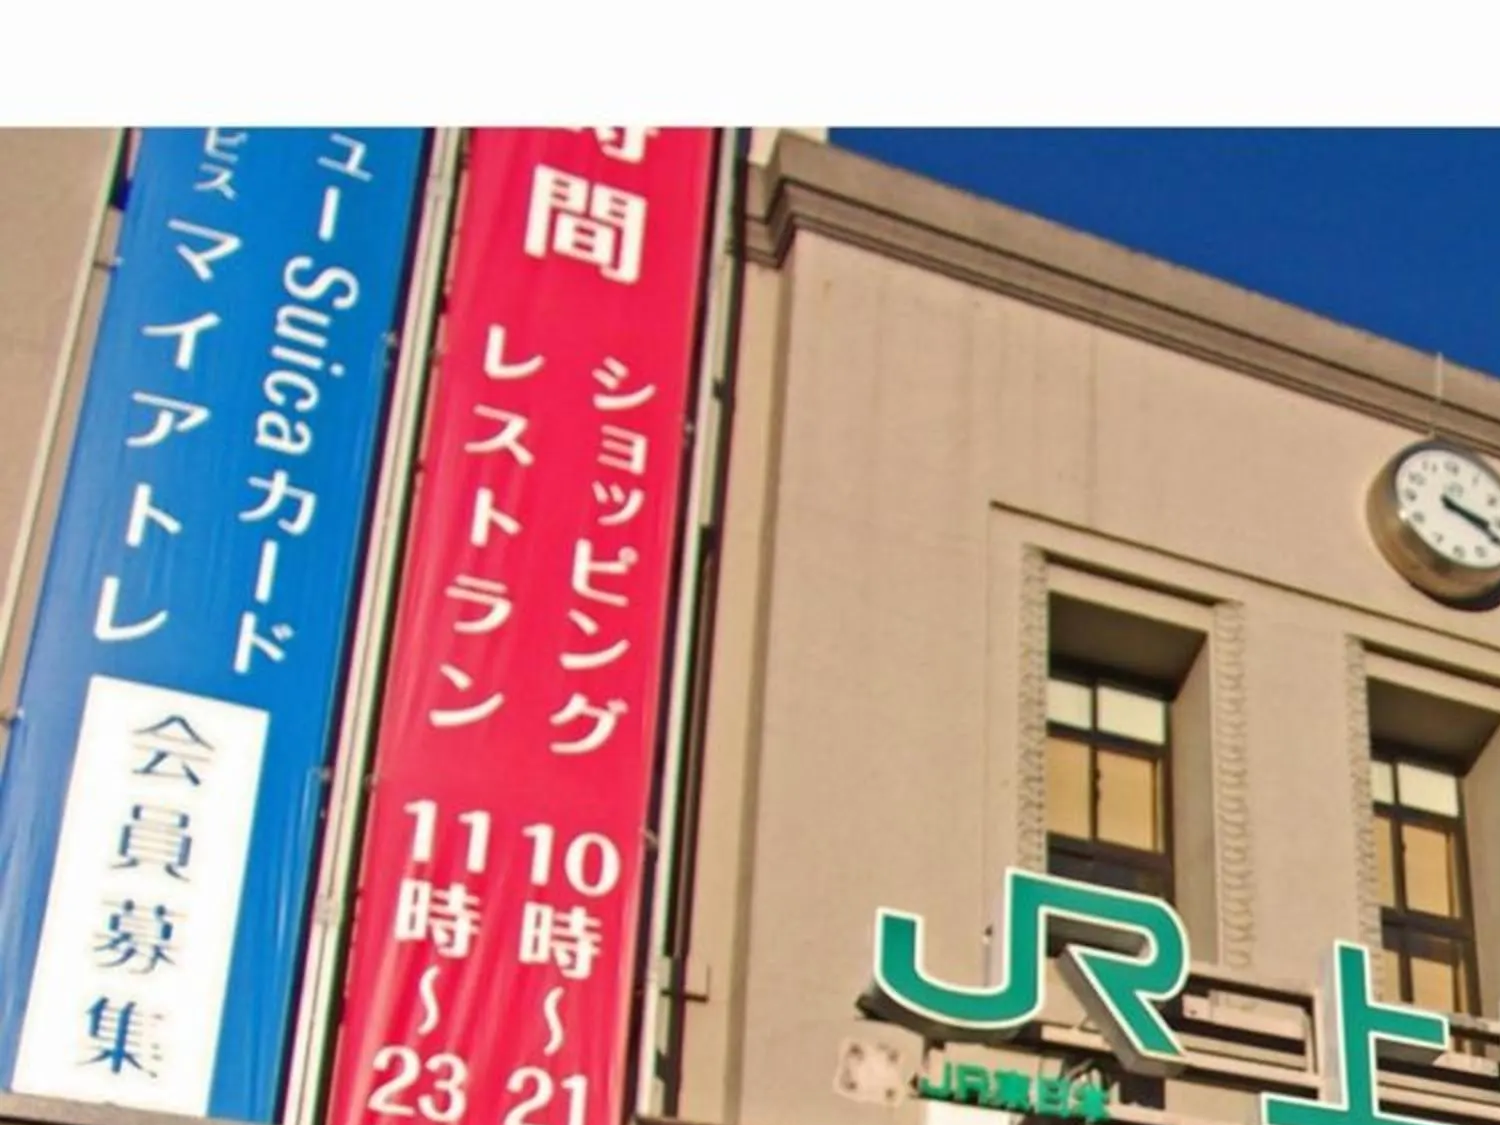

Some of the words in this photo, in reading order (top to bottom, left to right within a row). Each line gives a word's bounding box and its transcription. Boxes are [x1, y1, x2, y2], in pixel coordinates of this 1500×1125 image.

[430, 325, 545, 728] レストラン
[551, 357, 656, 754] ショッピング
[75, 713, 215, 1079] 会員募集
